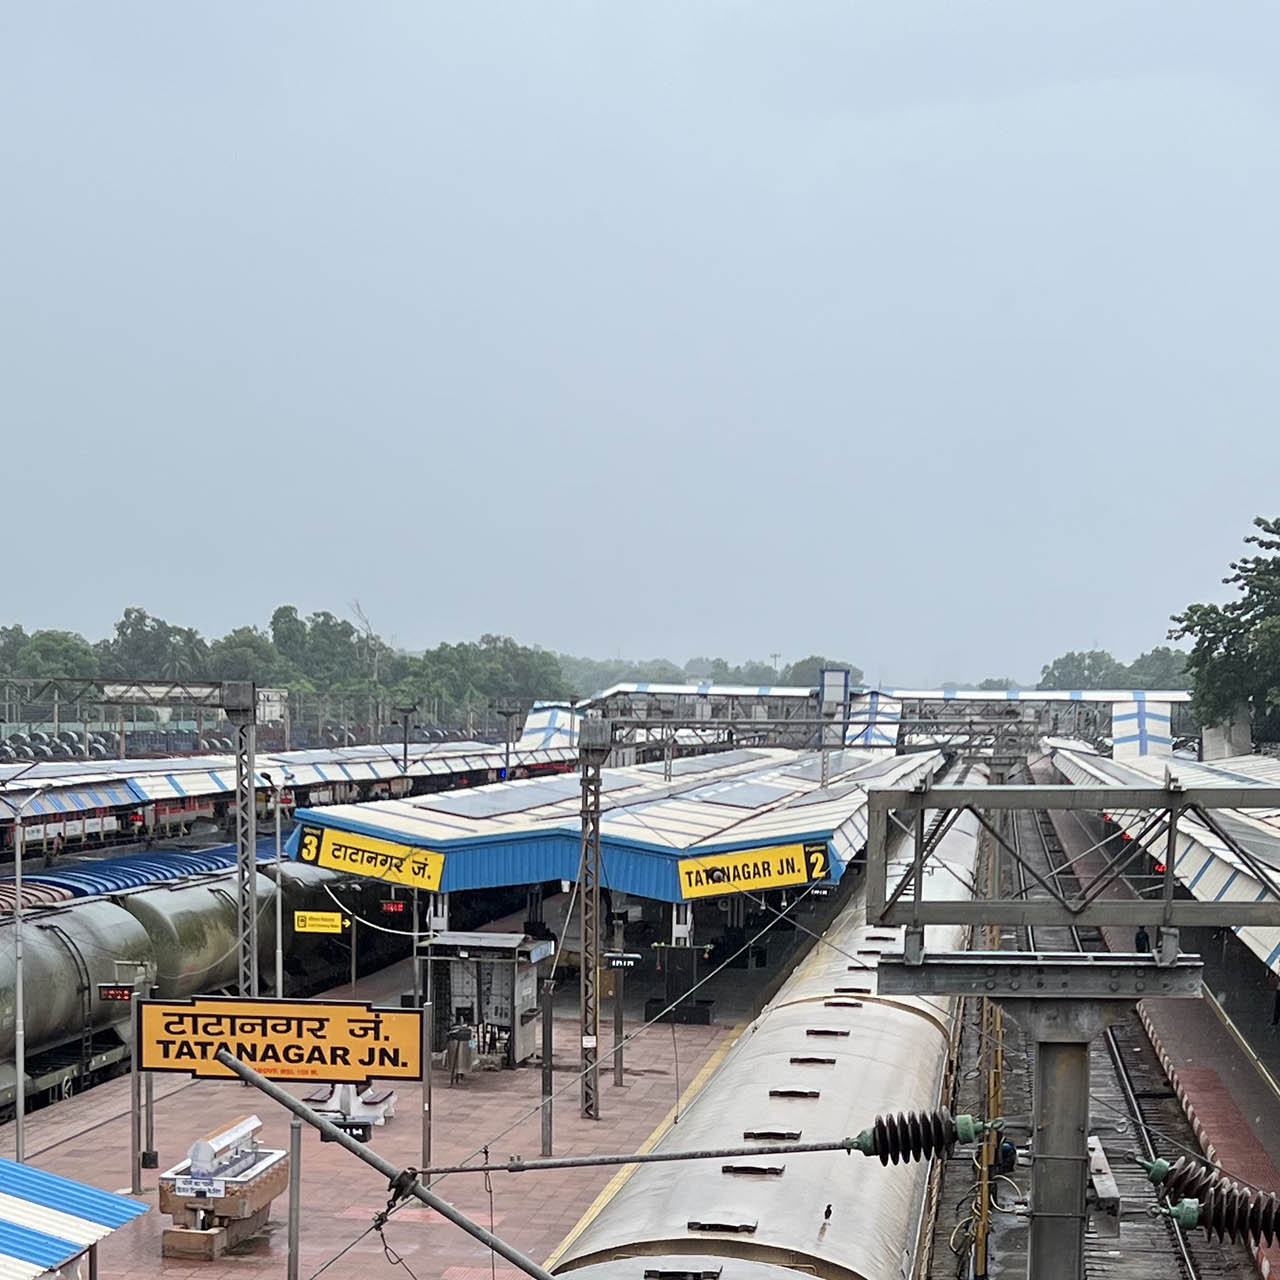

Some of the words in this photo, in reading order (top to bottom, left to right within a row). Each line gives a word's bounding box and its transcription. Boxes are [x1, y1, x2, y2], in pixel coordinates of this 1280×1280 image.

[302, 835, 318, 861] 3
[331, 842, 406, 873] टाटानगर
[412, 857, 431, 880] जं.
[777, 857, 801, 876] JN.
[810, 852, 826, 879] 2
[162, 1012, 329, 1040] टाटानगर
[347, 1013, 390, 1042] जं.
[156, 1039, 350, 1067] TATANAGAR
[358, 1047, 408, 1068] JN.
